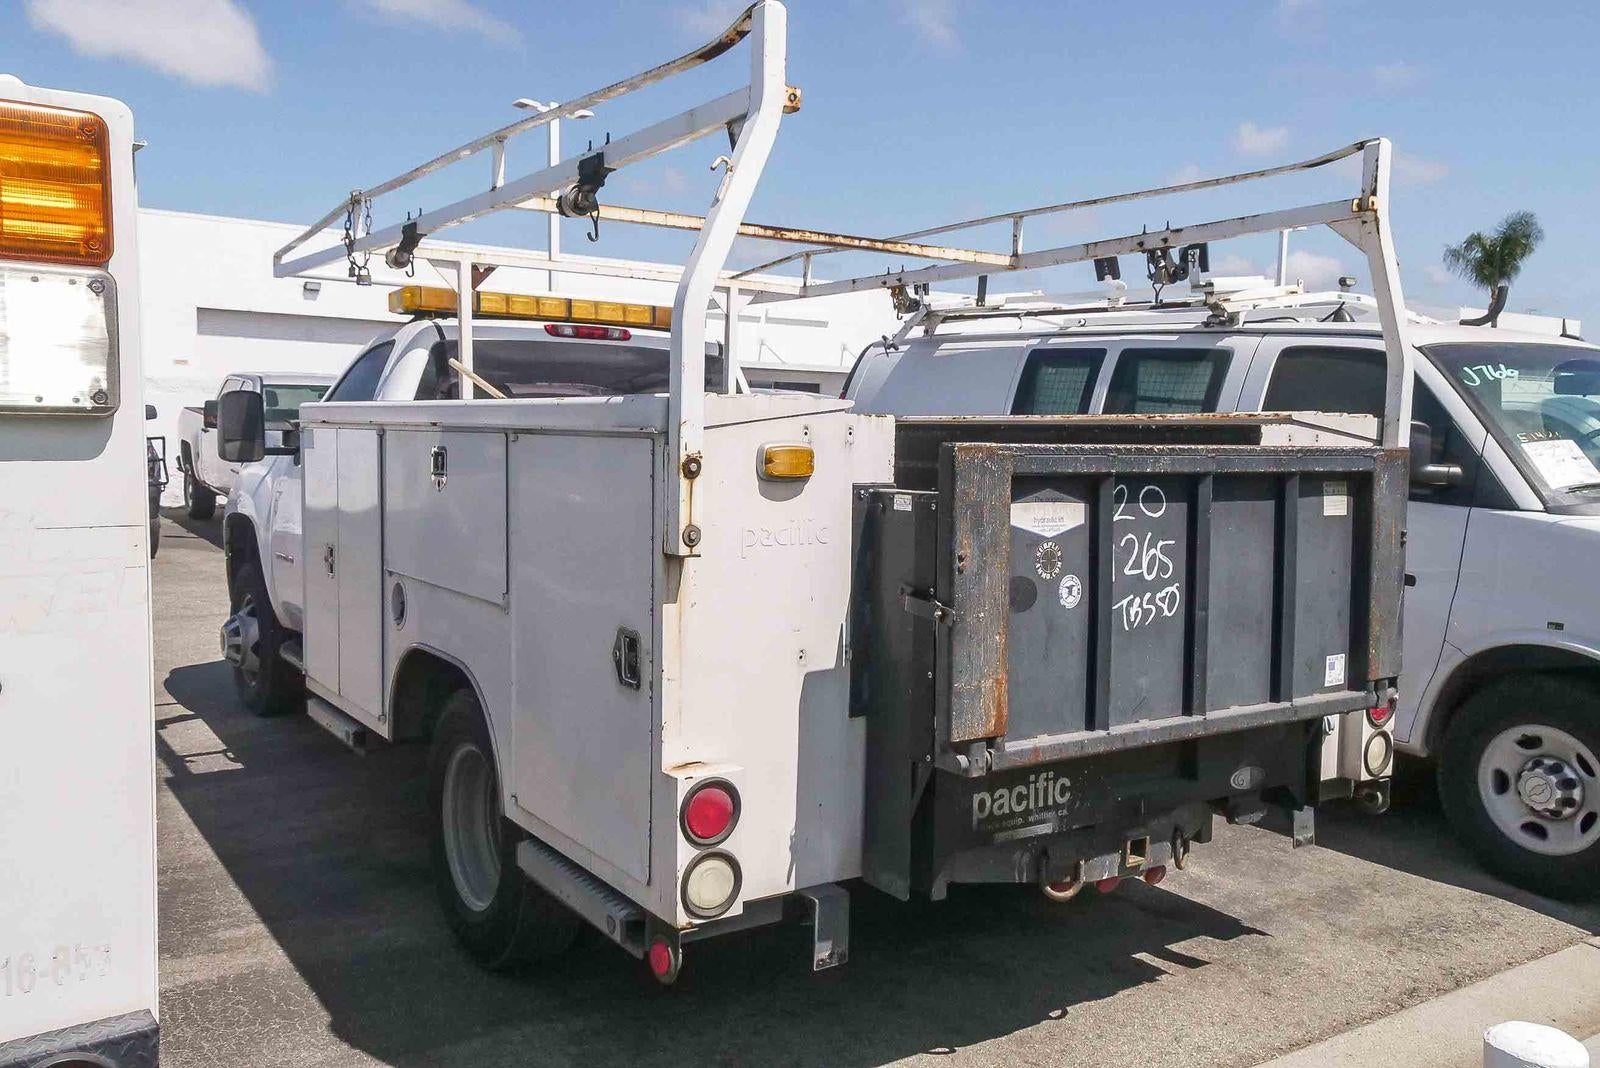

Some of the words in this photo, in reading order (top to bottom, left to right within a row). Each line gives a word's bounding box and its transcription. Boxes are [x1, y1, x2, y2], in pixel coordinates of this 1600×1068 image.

[1113, 484, 1167, 521] 20
[739, 518, 832, 559] pacific
[1112, 532, 1176, 582] 1265
[972, 771, 1071, 831] pacific
